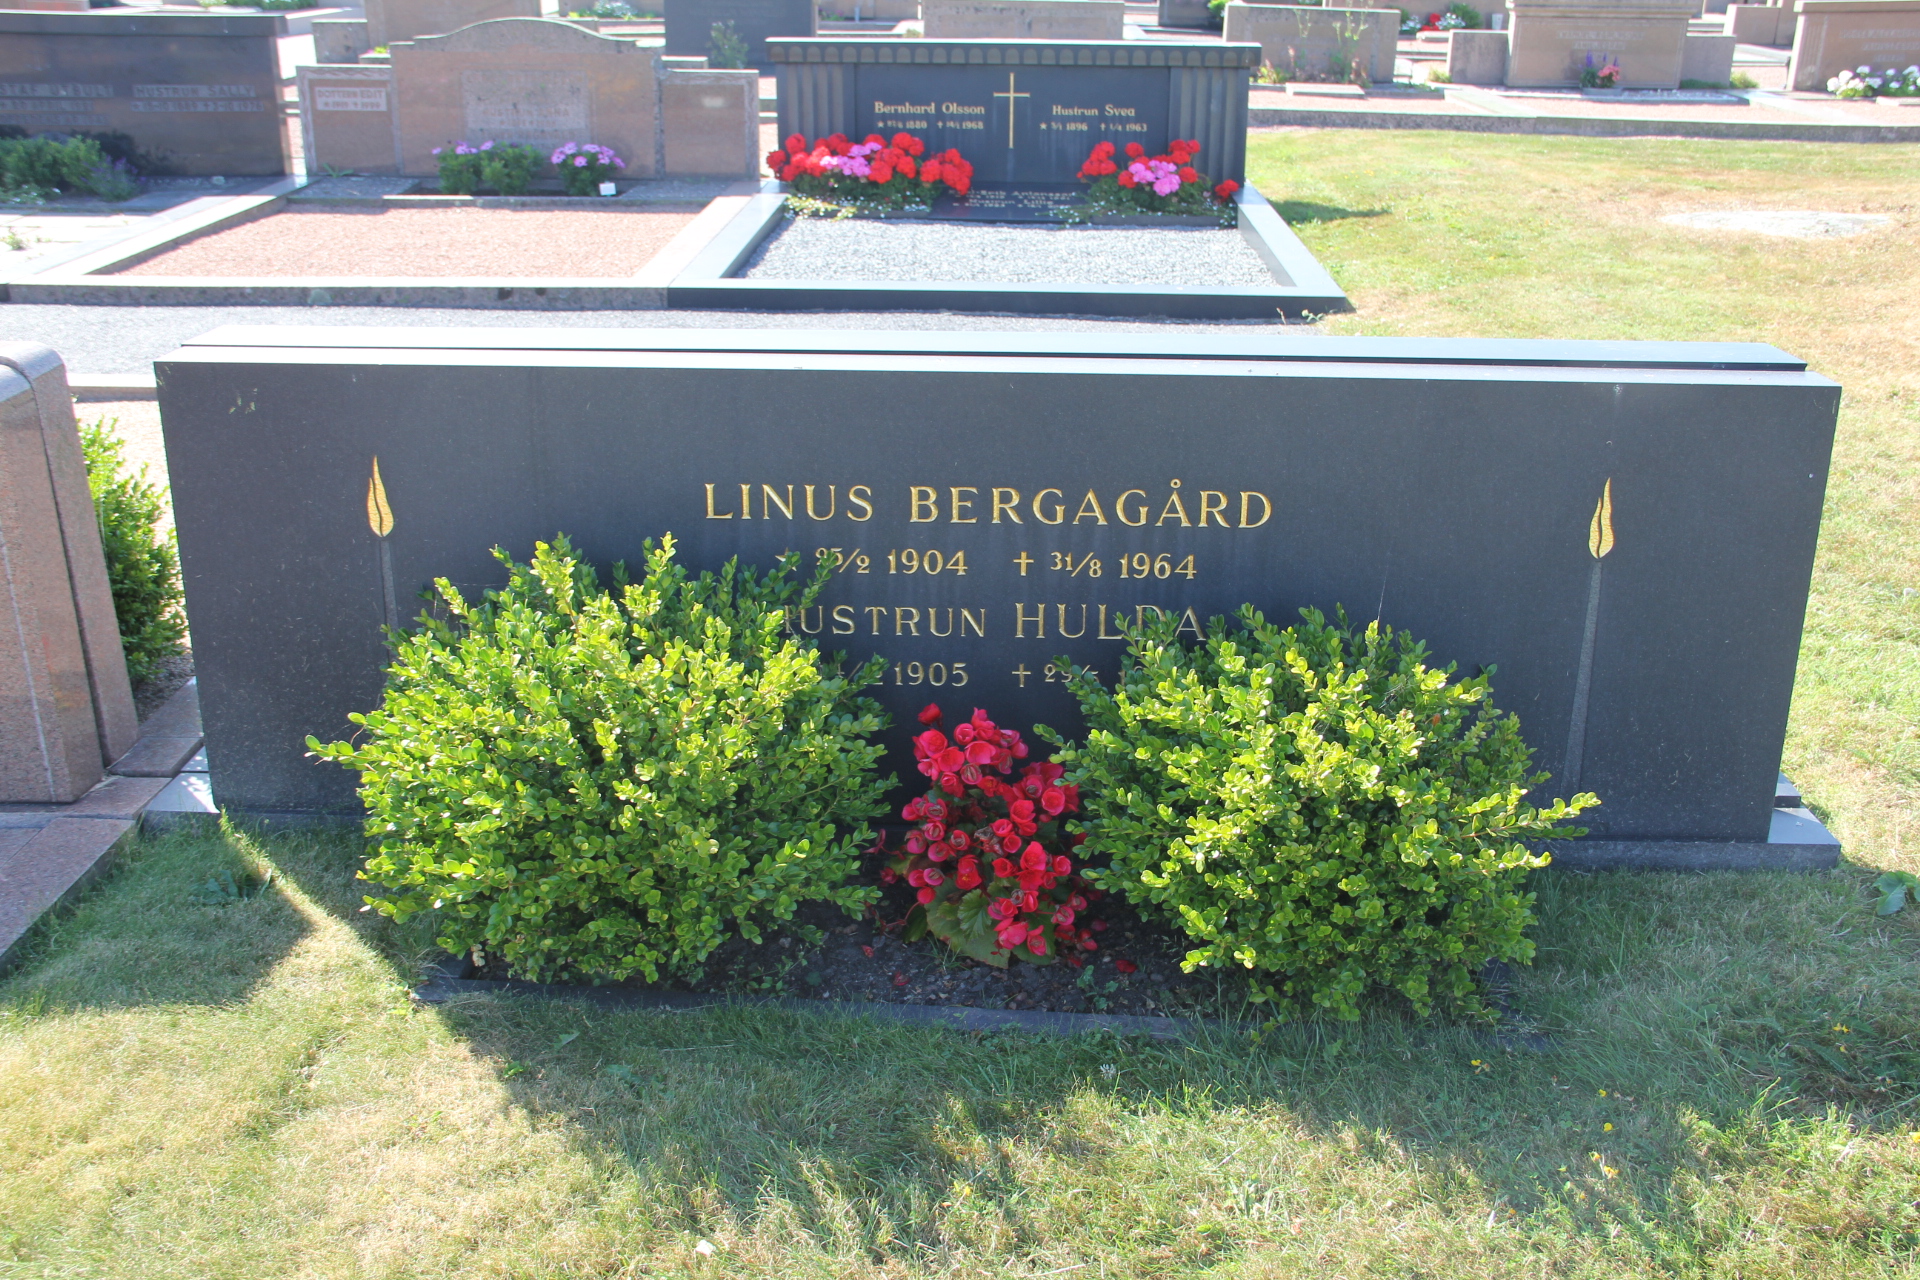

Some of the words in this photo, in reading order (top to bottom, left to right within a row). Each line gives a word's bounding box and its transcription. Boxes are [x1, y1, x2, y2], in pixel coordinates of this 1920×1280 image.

[135, 85, 200, 98] HUSTRUN
[208, 85, 253, 98] SALLY
[360, 89, 383, 99] EDIT
[874, 101, 936, 114] Bernhard
[942, 102, 985, 115] Olsson
[1052, 105, 1098, 116] Hustrun
[1105, 104, 1136, 117] Svea
[906, 120, 928, 130] 1880
[962, 121, 984, 130] 1968
[1066, 122, 1089, 132] 1896
[1125, 123, 1148, 132] 1963
[704, 483, 874, 522] LINUS
[908, 478, 1274, 530] BERGAGÅRD
[886, 548, 969, 576] 1904
[1049, 551, 1103, 579] 31/8
[1118, 552, 1198, 580] 1964
[1014, 602, 1207, 641] HULDA
[893, 661, 969, 688] 1905
